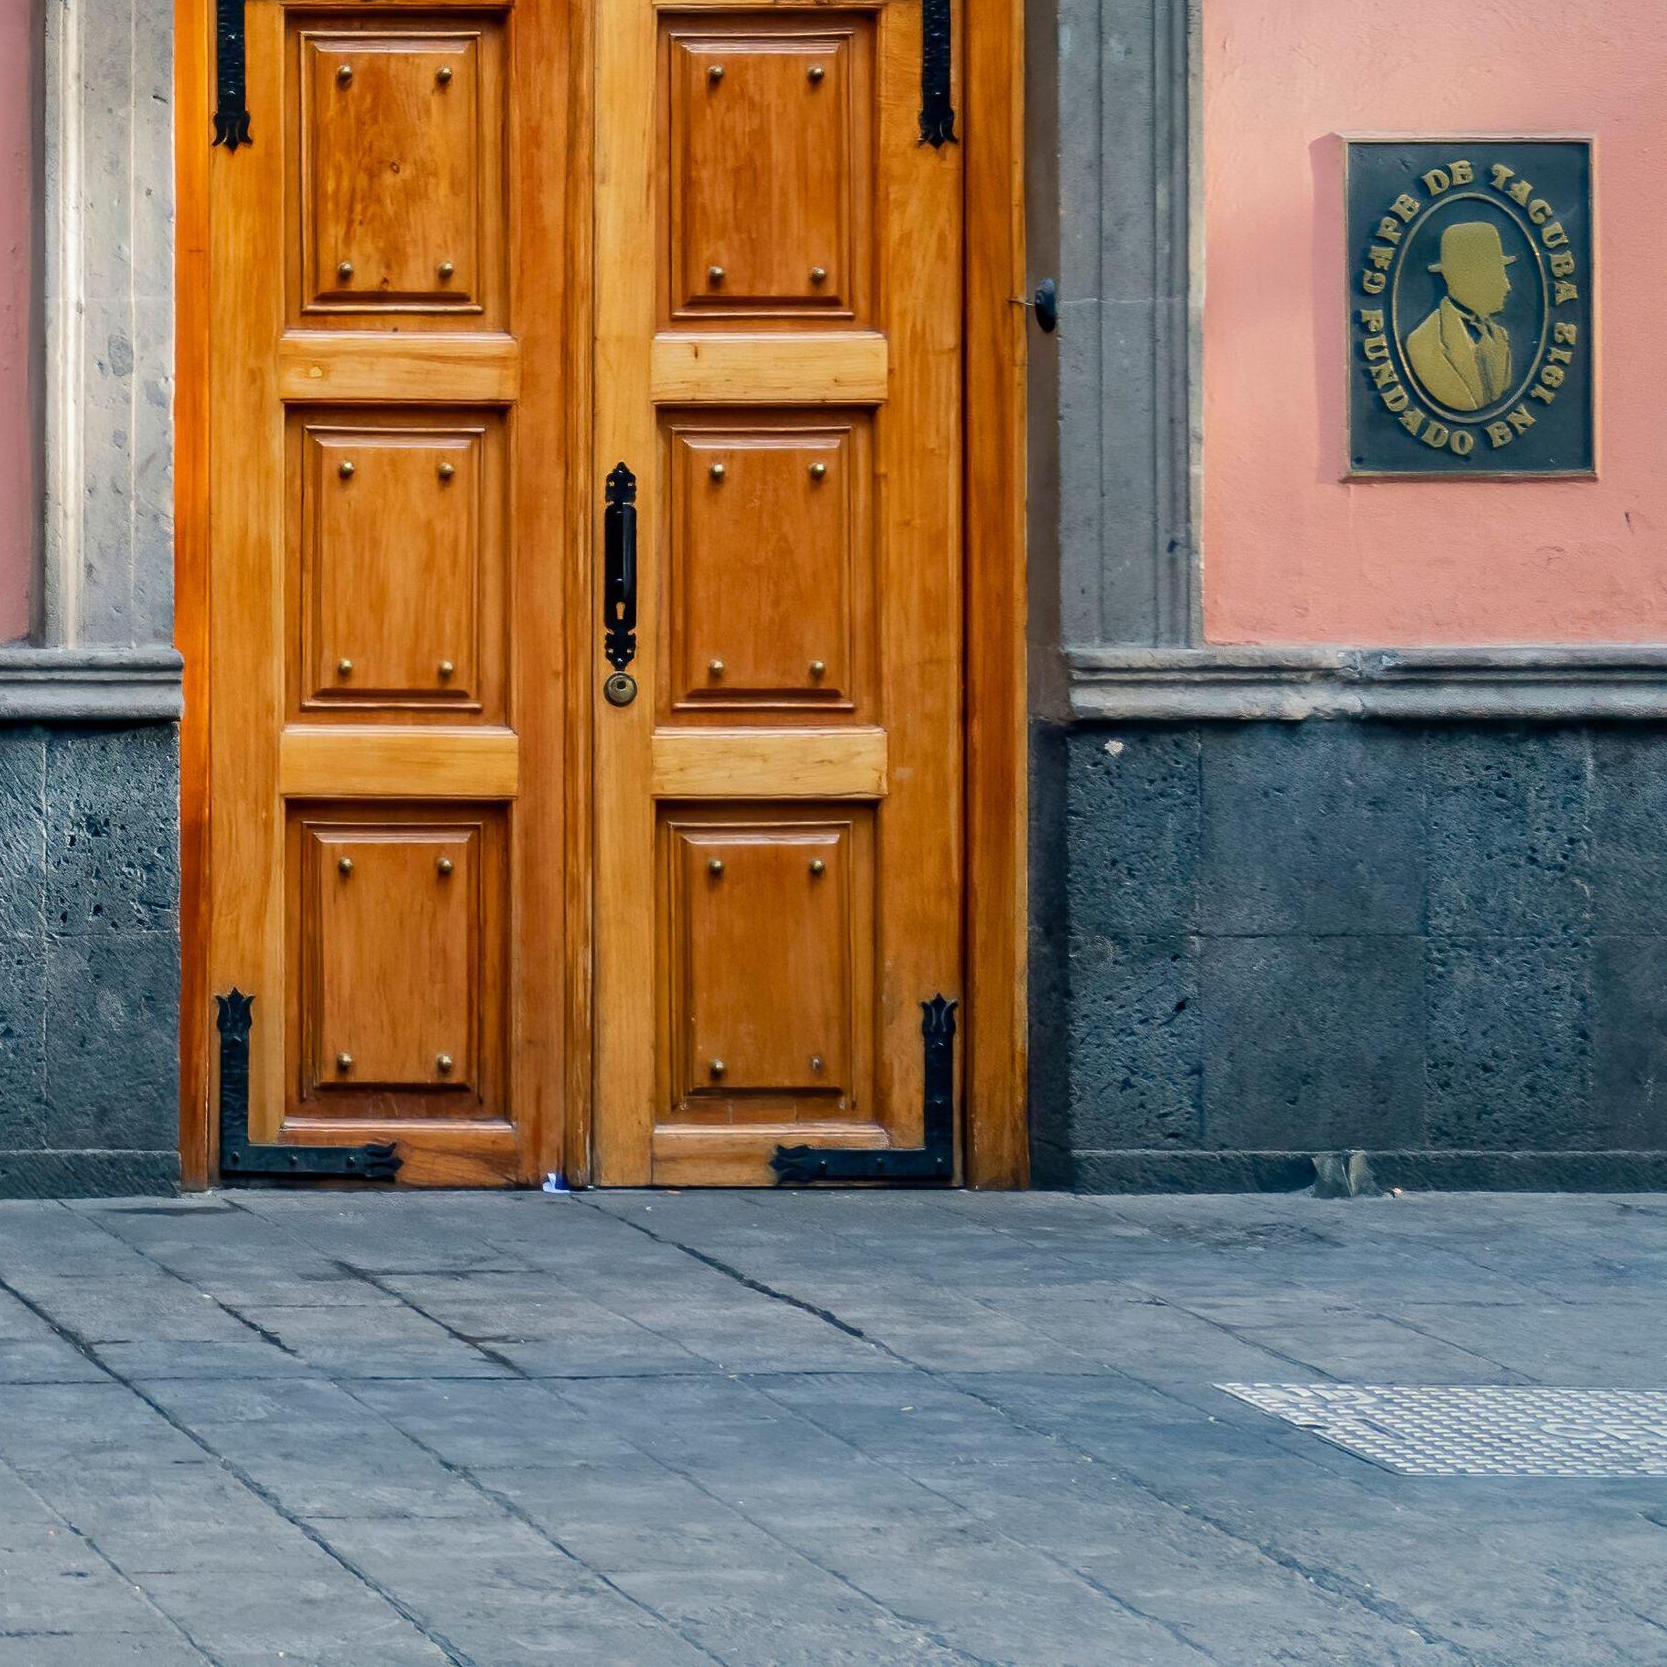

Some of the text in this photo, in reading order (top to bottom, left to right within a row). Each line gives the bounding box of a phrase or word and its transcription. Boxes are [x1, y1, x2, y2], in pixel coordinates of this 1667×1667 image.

[1363, 160, 1578, 306] CAFE DE TACUBA
[1361, 309, 1578, 456] FUNDADO EN 1912
